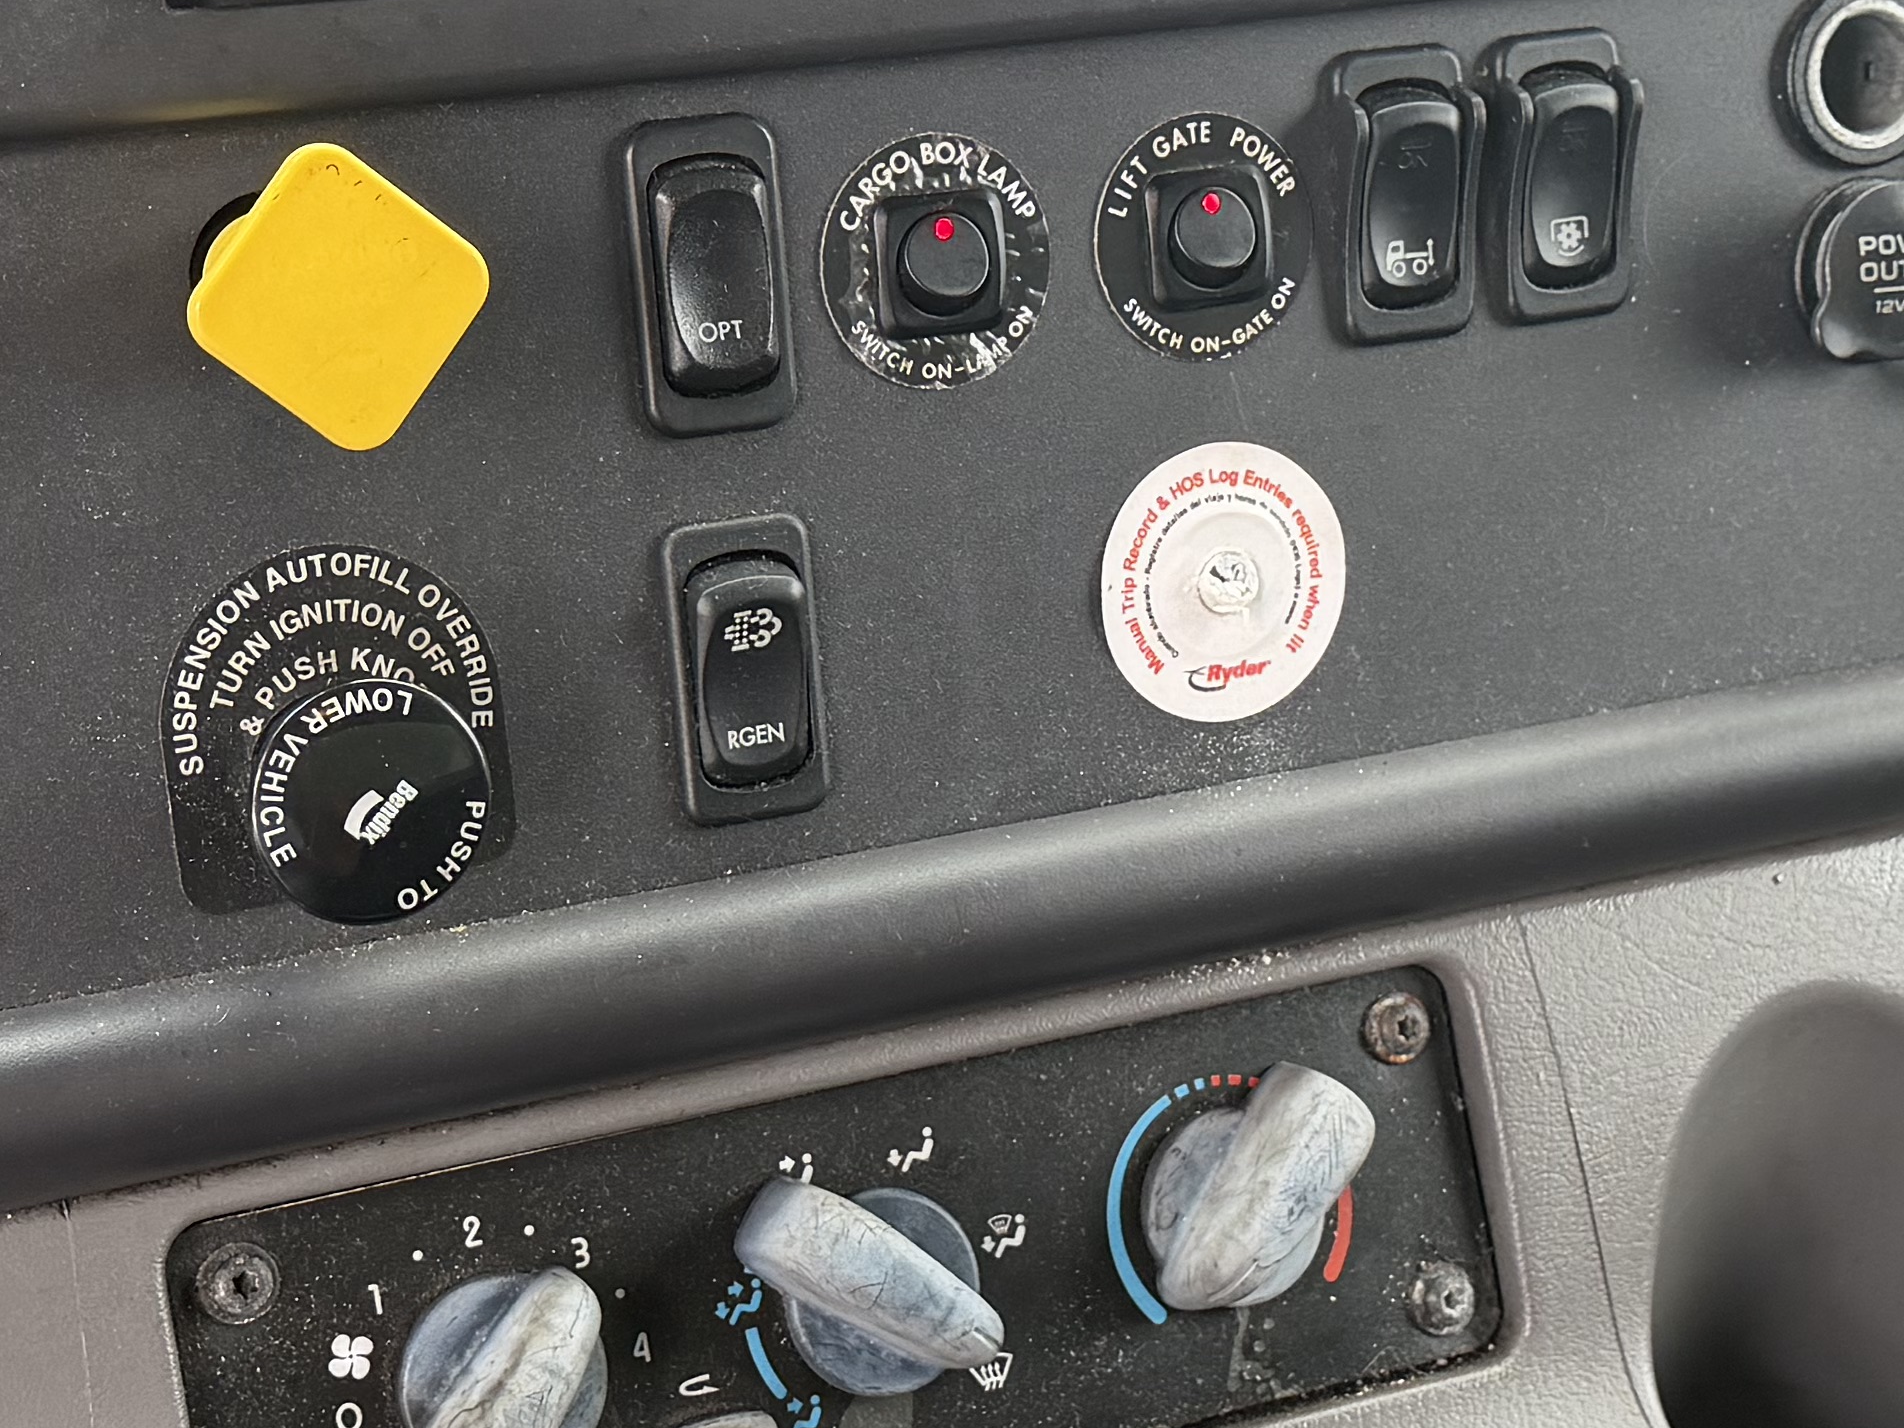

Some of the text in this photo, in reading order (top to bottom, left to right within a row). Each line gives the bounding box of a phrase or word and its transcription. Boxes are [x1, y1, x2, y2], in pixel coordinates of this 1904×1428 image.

[840, 141, 1037, 232] CARGO BOX LAMP
[1107, 121, 1296, 217] LIFT GATE POWER
[698, 320, 744, 344] OPT
[851, 320, 914, 376] SWITCH
[1008, 305, 1034, 338] ON
[1123, 277, 1296, 353] SWITCH ON-GATE ON
[1156, 495, 1171, 511] &
[1169, 471, 1205, 500] HOS
[1208, 468, 1239, 486] Log
[1243, 469, 1293, 509] Entries
[1123, 508, 1159, 572] Record
[1292, 508, 1323, 579] required
[1121, 576, 1137, 615] Trip
[1298, 584, 1321, 631] when
[173, 551, 493, 776] SUSPENSION AUTOFILL OVERRIDE
[210, 598, 456, 710] TURN IGNITION OFF
[1125, 617, 1165, 675] Manual
[1206, 659, 1271, 684] Ryder
[239, 646, 428, 737] & PUSH KNO
[728, 722, 786, 750] RGEN
[259, 688, 414, 868] LOWER VEHICLE
[360, 779, 419, 845] Bendix
[397, 801, 487, 911] PUSH TO
[367, 1215, 651, 1362] 1 2 3 4
